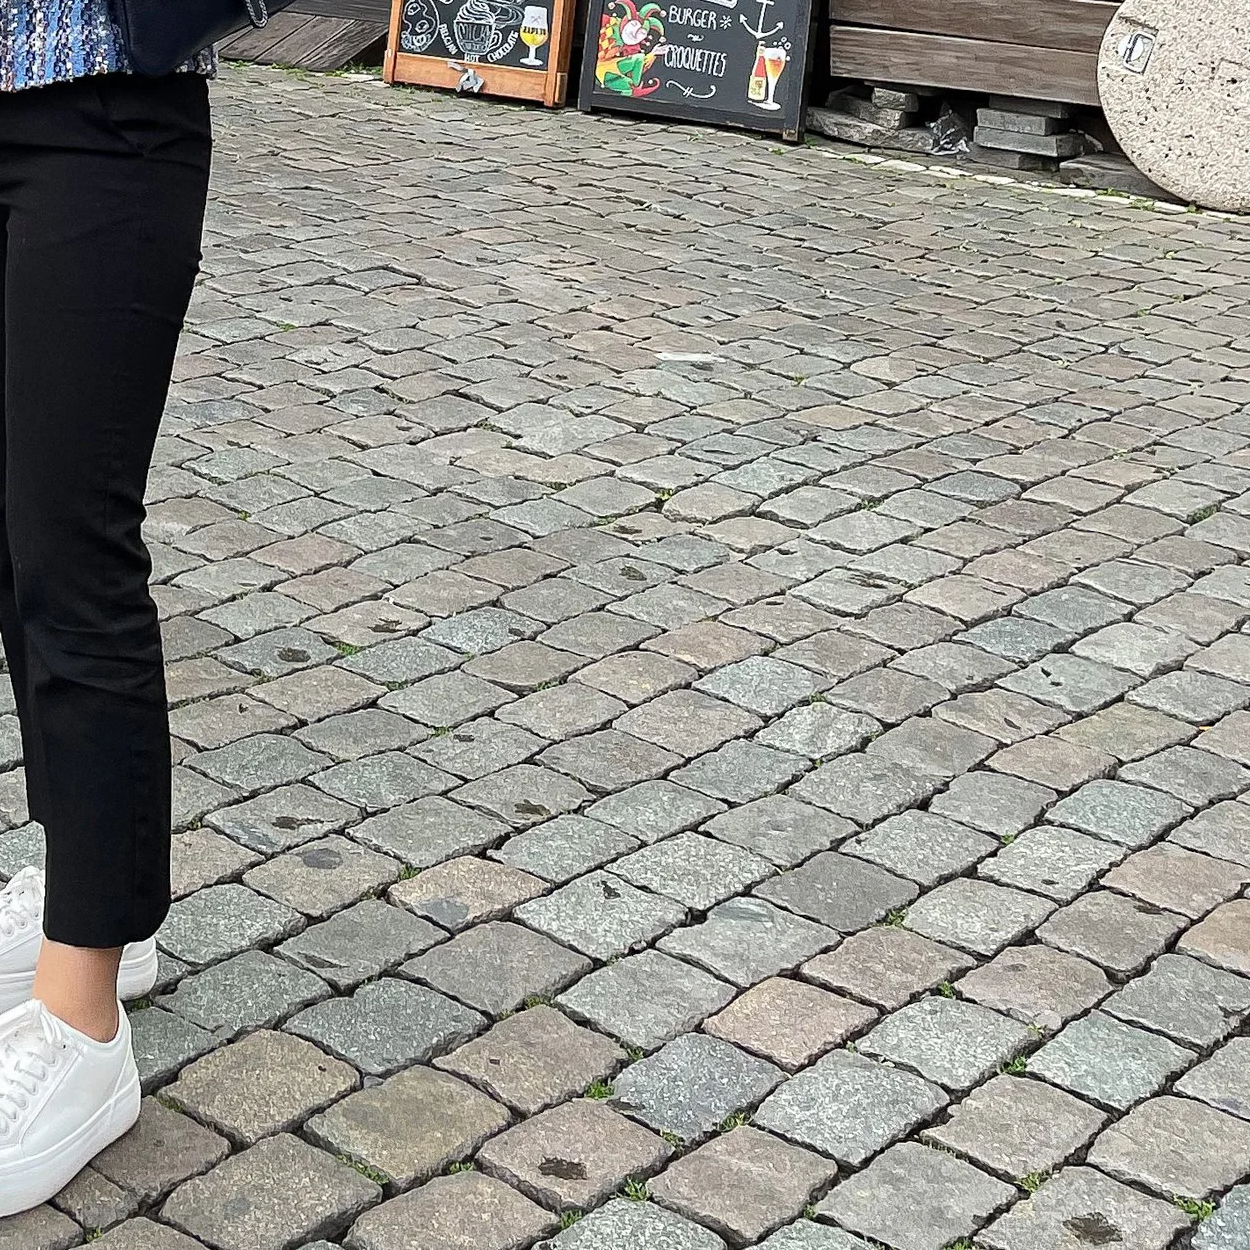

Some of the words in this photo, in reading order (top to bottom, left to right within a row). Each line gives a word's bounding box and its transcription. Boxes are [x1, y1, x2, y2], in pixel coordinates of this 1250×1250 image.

[668, 5, 717, 31] BURGER
[464, 53, 481, 63] HOT
[664, 44, 728, 77] CROQUETTES
